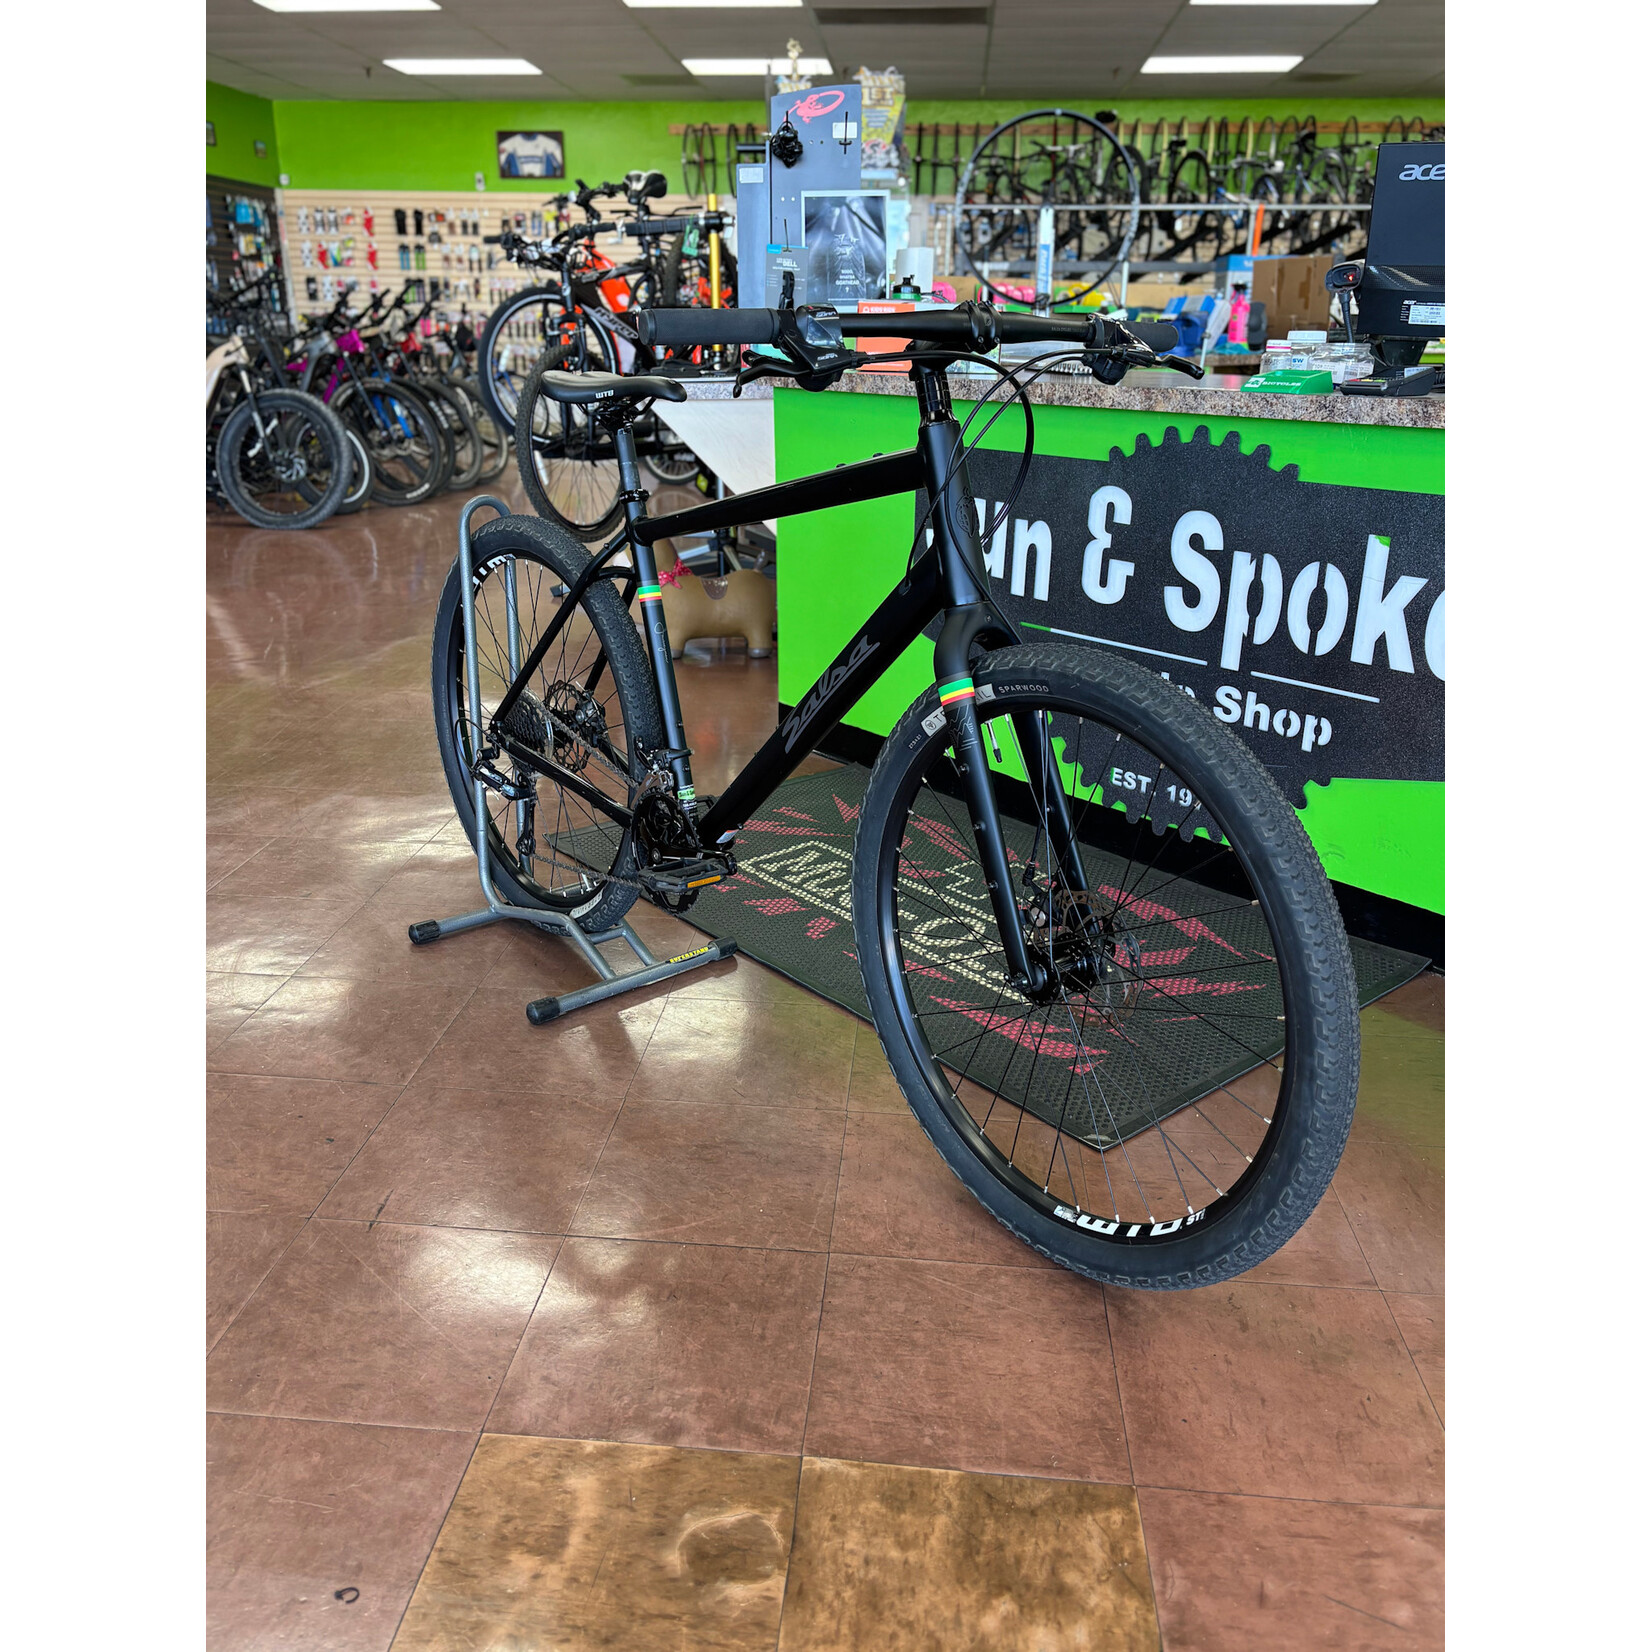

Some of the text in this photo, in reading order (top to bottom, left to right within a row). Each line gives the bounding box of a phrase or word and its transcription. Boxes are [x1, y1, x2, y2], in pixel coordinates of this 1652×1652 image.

[595, 390, 614, 398] WTB
[1082, 485, 1135, 605] &
[781, 634, 881, 754] Salsa
[998, 684, 1050, 694] SPARWOOD
[1213, 685, 1332, 752] Shop
